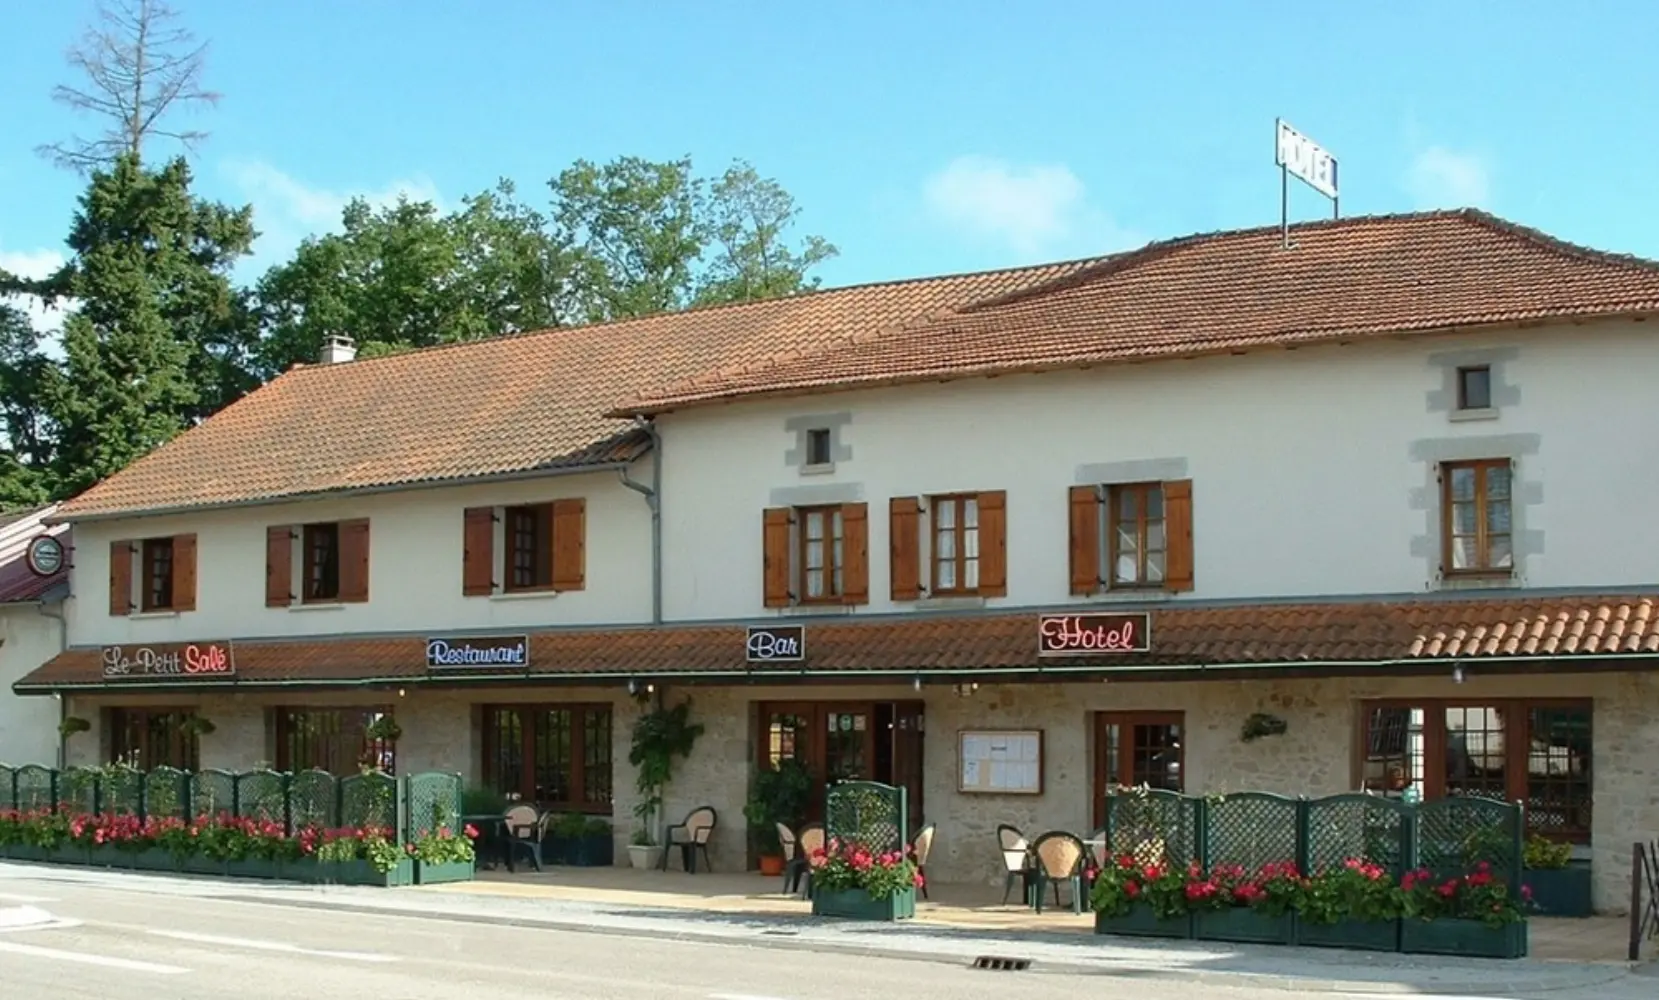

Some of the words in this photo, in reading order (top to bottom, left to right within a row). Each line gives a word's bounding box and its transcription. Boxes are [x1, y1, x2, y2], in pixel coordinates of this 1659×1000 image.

[747, 631, 798, 658] Bar
[1041, 616, 1133, 650] Hotel
[103, 646, 131, 674] Le
[135, 647, 181, 673] Petit
[184, 645, 227, 673] Salé
[427, 640, 524, 665] Restaurant
